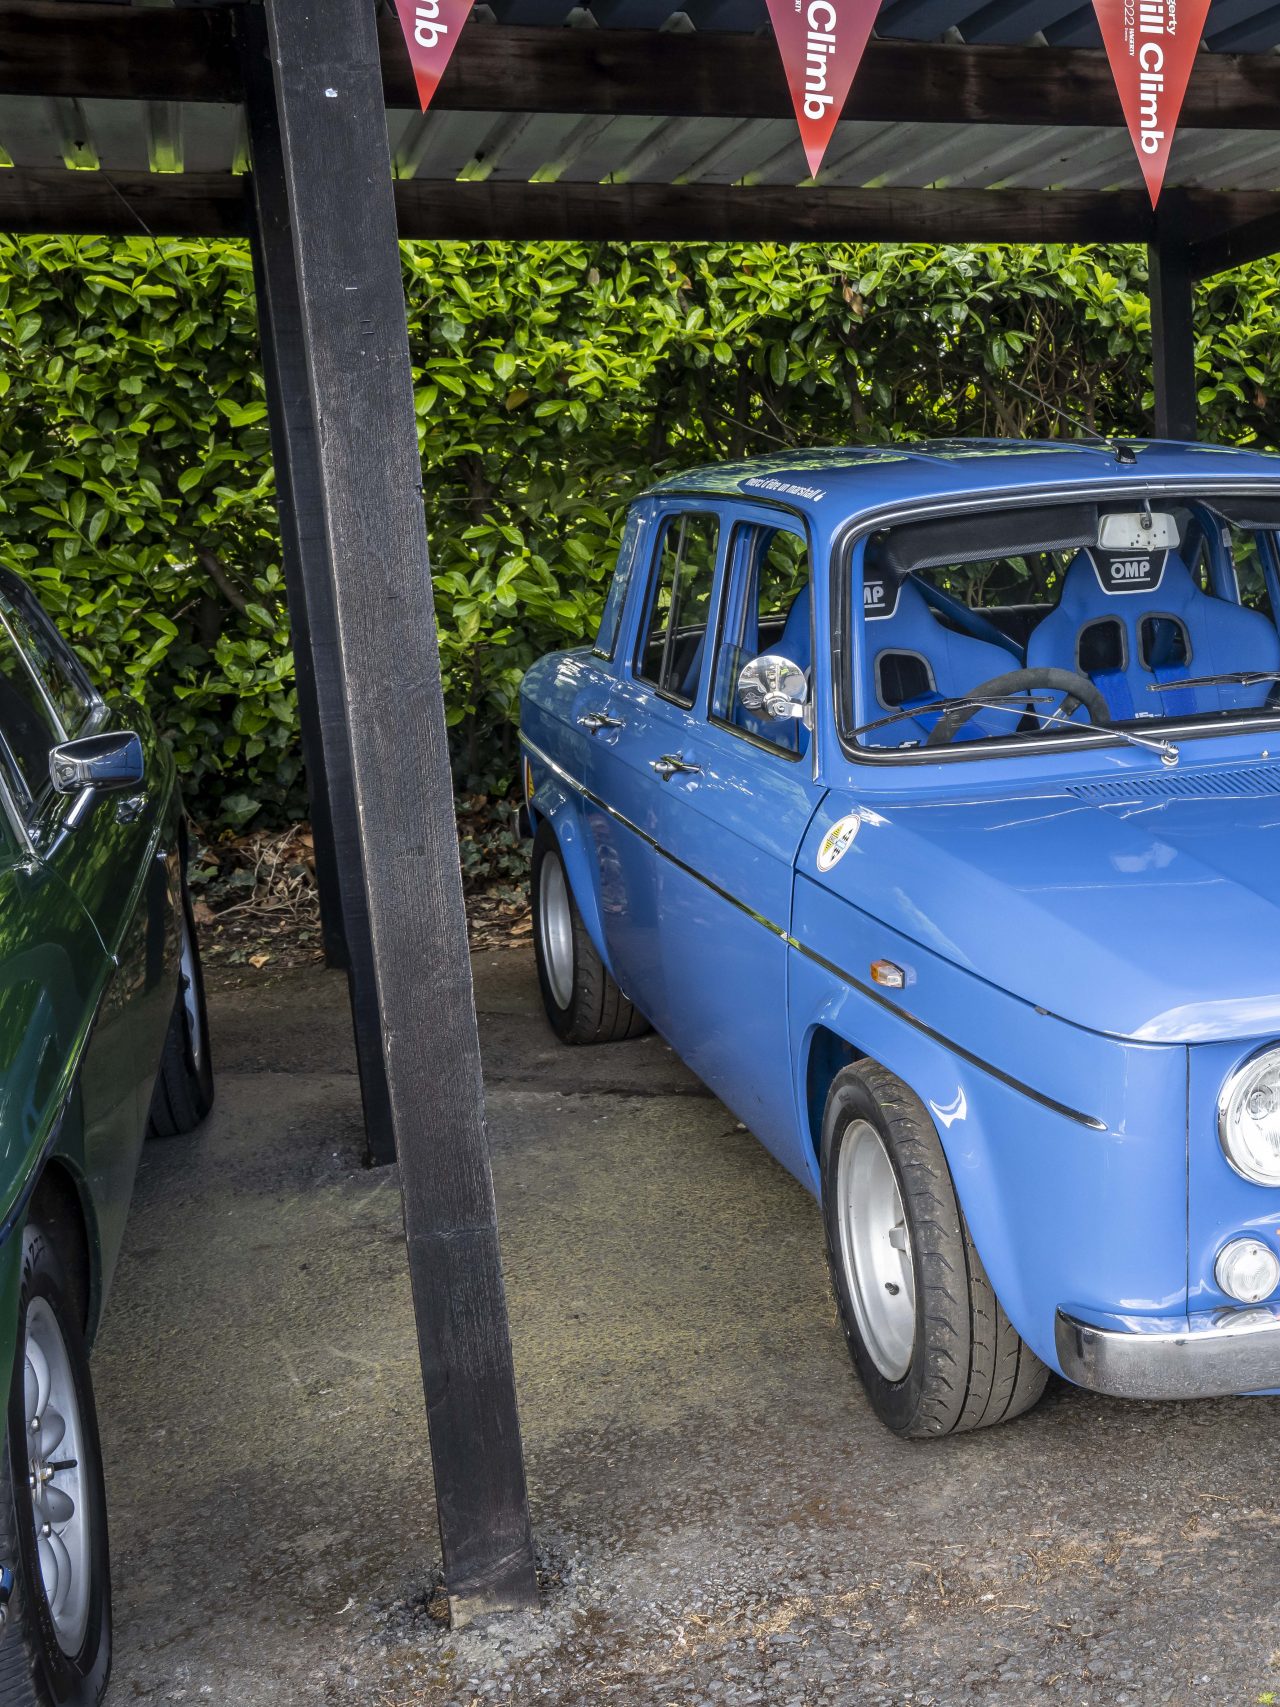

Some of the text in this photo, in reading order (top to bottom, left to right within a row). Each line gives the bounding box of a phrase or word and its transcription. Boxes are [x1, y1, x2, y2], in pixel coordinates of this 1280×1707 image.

[803, 0, 837, 120] Climb
[1139, 0, 1164, 155] ill Climb
[863, 585, 885, 604] MP
[1110, 561, 1150, 579] OMP
